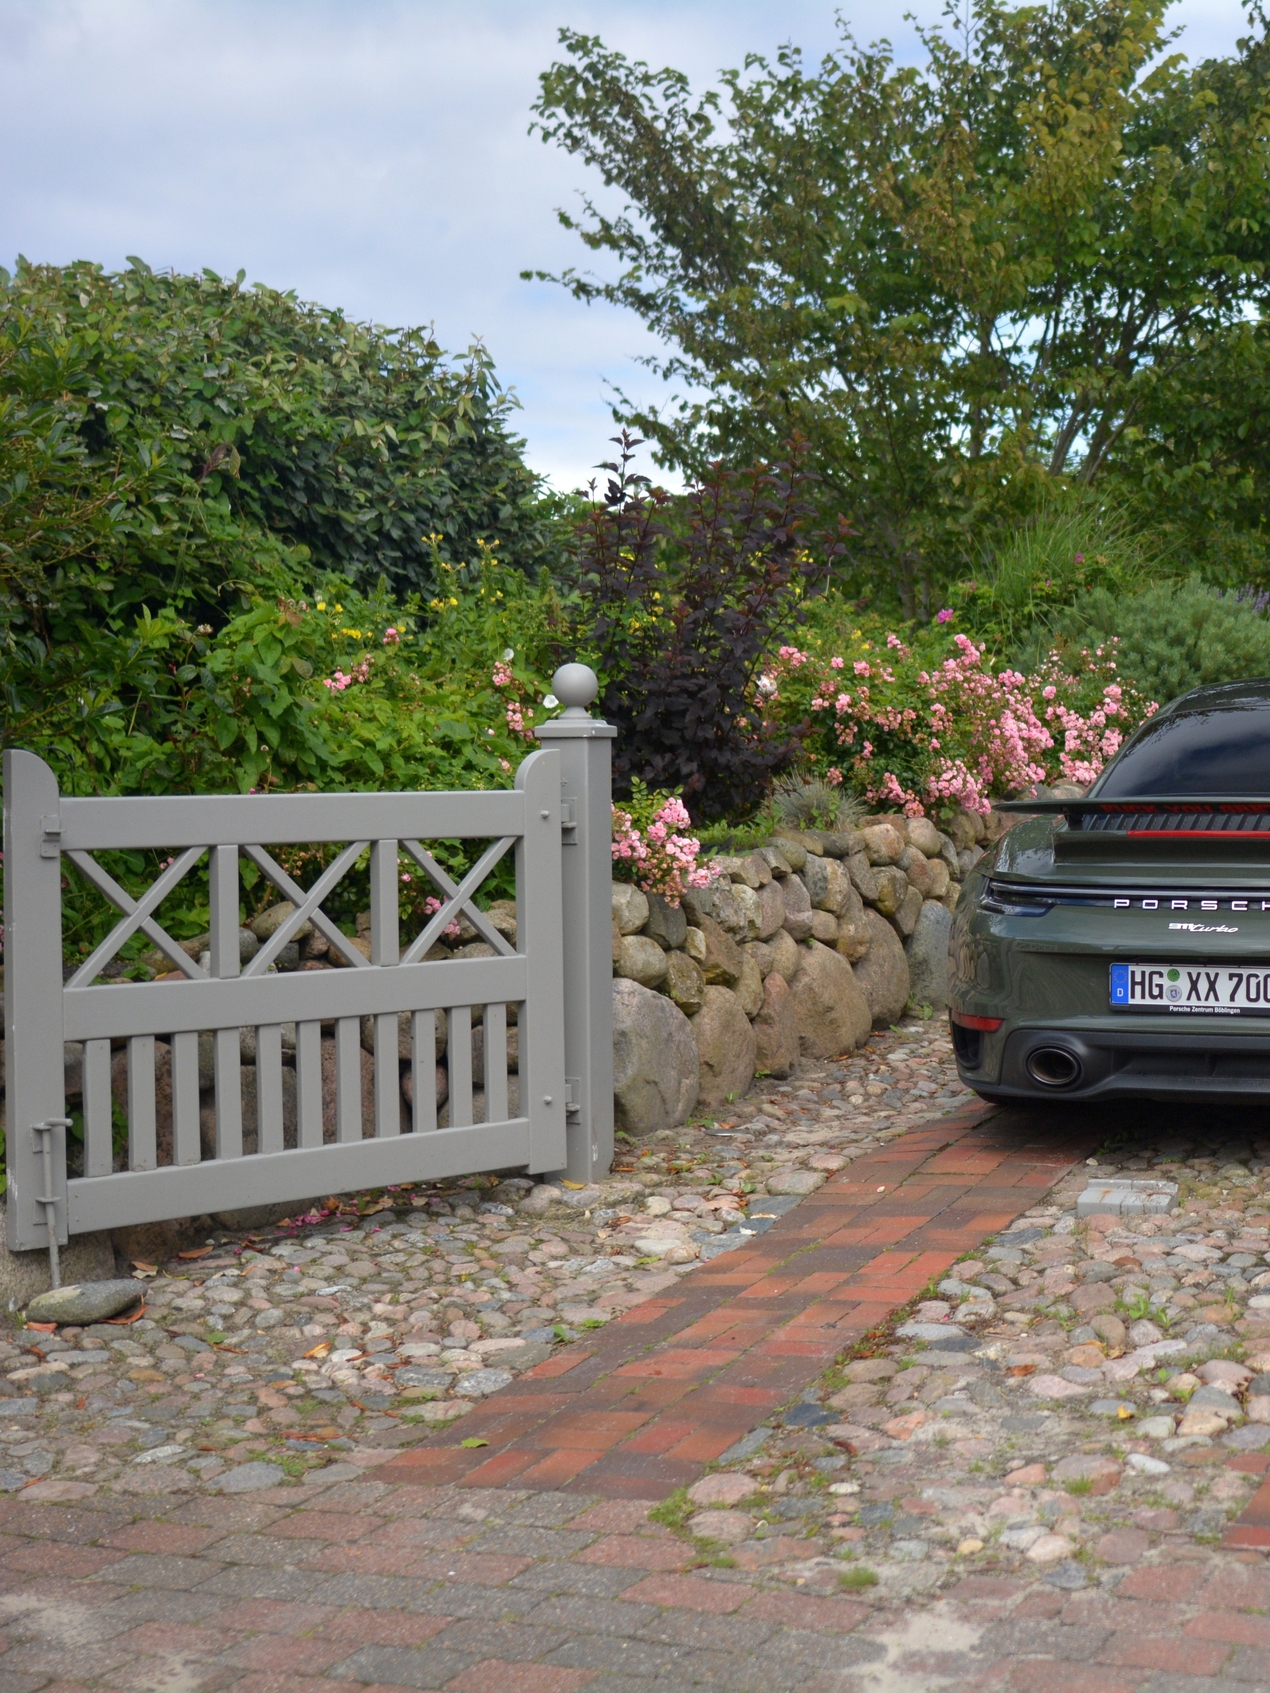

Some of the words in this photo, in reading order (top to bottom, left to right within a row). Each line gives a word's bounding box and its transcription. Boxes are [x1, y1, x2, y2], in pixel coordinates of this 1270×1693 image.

[1130, 970, 1164, 1000] HG
[1186, 971, 1220, 1002] XX
[1116, 988, 1124, 997] D
[1214, 1006, 1241, 1015] Böblingen
